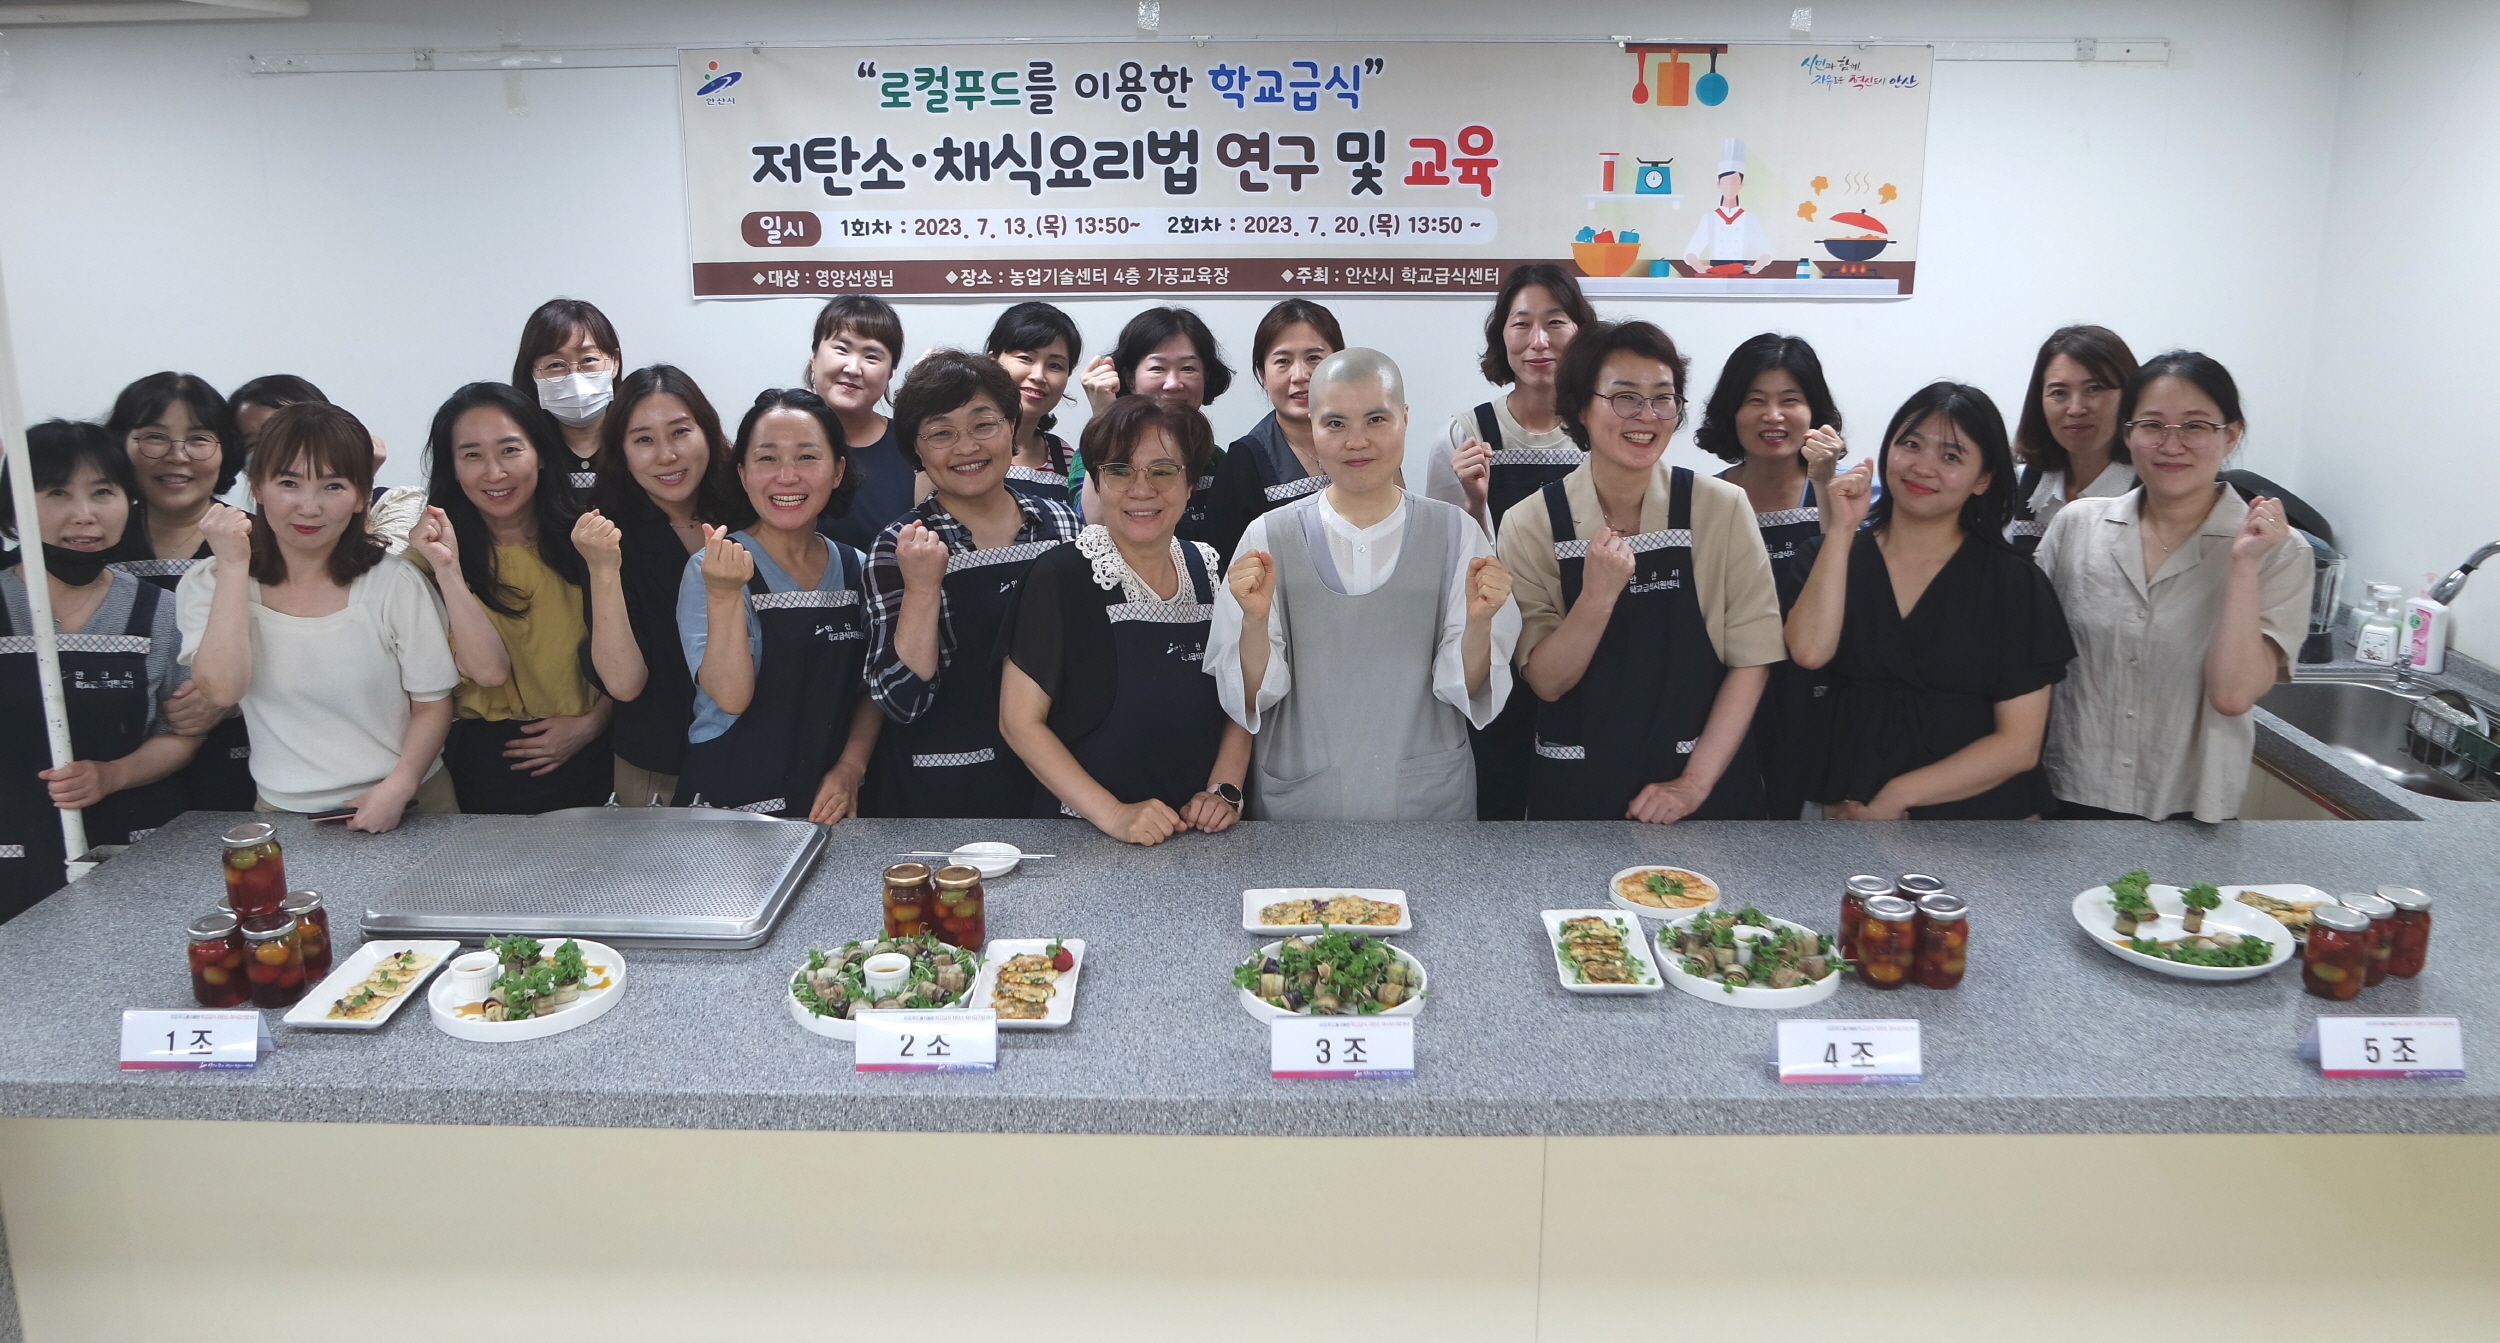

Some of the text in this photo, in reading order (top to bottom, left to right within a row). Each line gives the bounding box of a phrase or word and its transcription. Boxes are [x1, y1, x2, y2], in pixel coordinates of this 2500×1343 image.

[1074, 61, 1193, 113] 이용한
[1889, 74, 1920, 89] 안산
[705, 97, 735, 106] 안산시
[1216, 131, 1320, 192] 연구
[1336, 129, 1386, 196] 및
[1404, 125, 1499, 198] 교육
[759, 215, 805, 245] 일시
[840, 217, 893, 237] 1회차
[914, 217, 969, 239] 2023.
[1167, 215, 1222, 234] 2회차
[1244, 216, 1300, 237] 2023.
[1408, 216, 1463, 234] 13:50
[815, 269, 895, 288] 영양선생님
[1008, 267, 1108, 287] 농업기술센터
[1113, 267, 1142, 286] 4층
[1146, 266, 1231, 286] 가공교육장
[1345, 266, 1394, 285] 안산시
[1400, 266, 1500, 285] 학교급식센터
